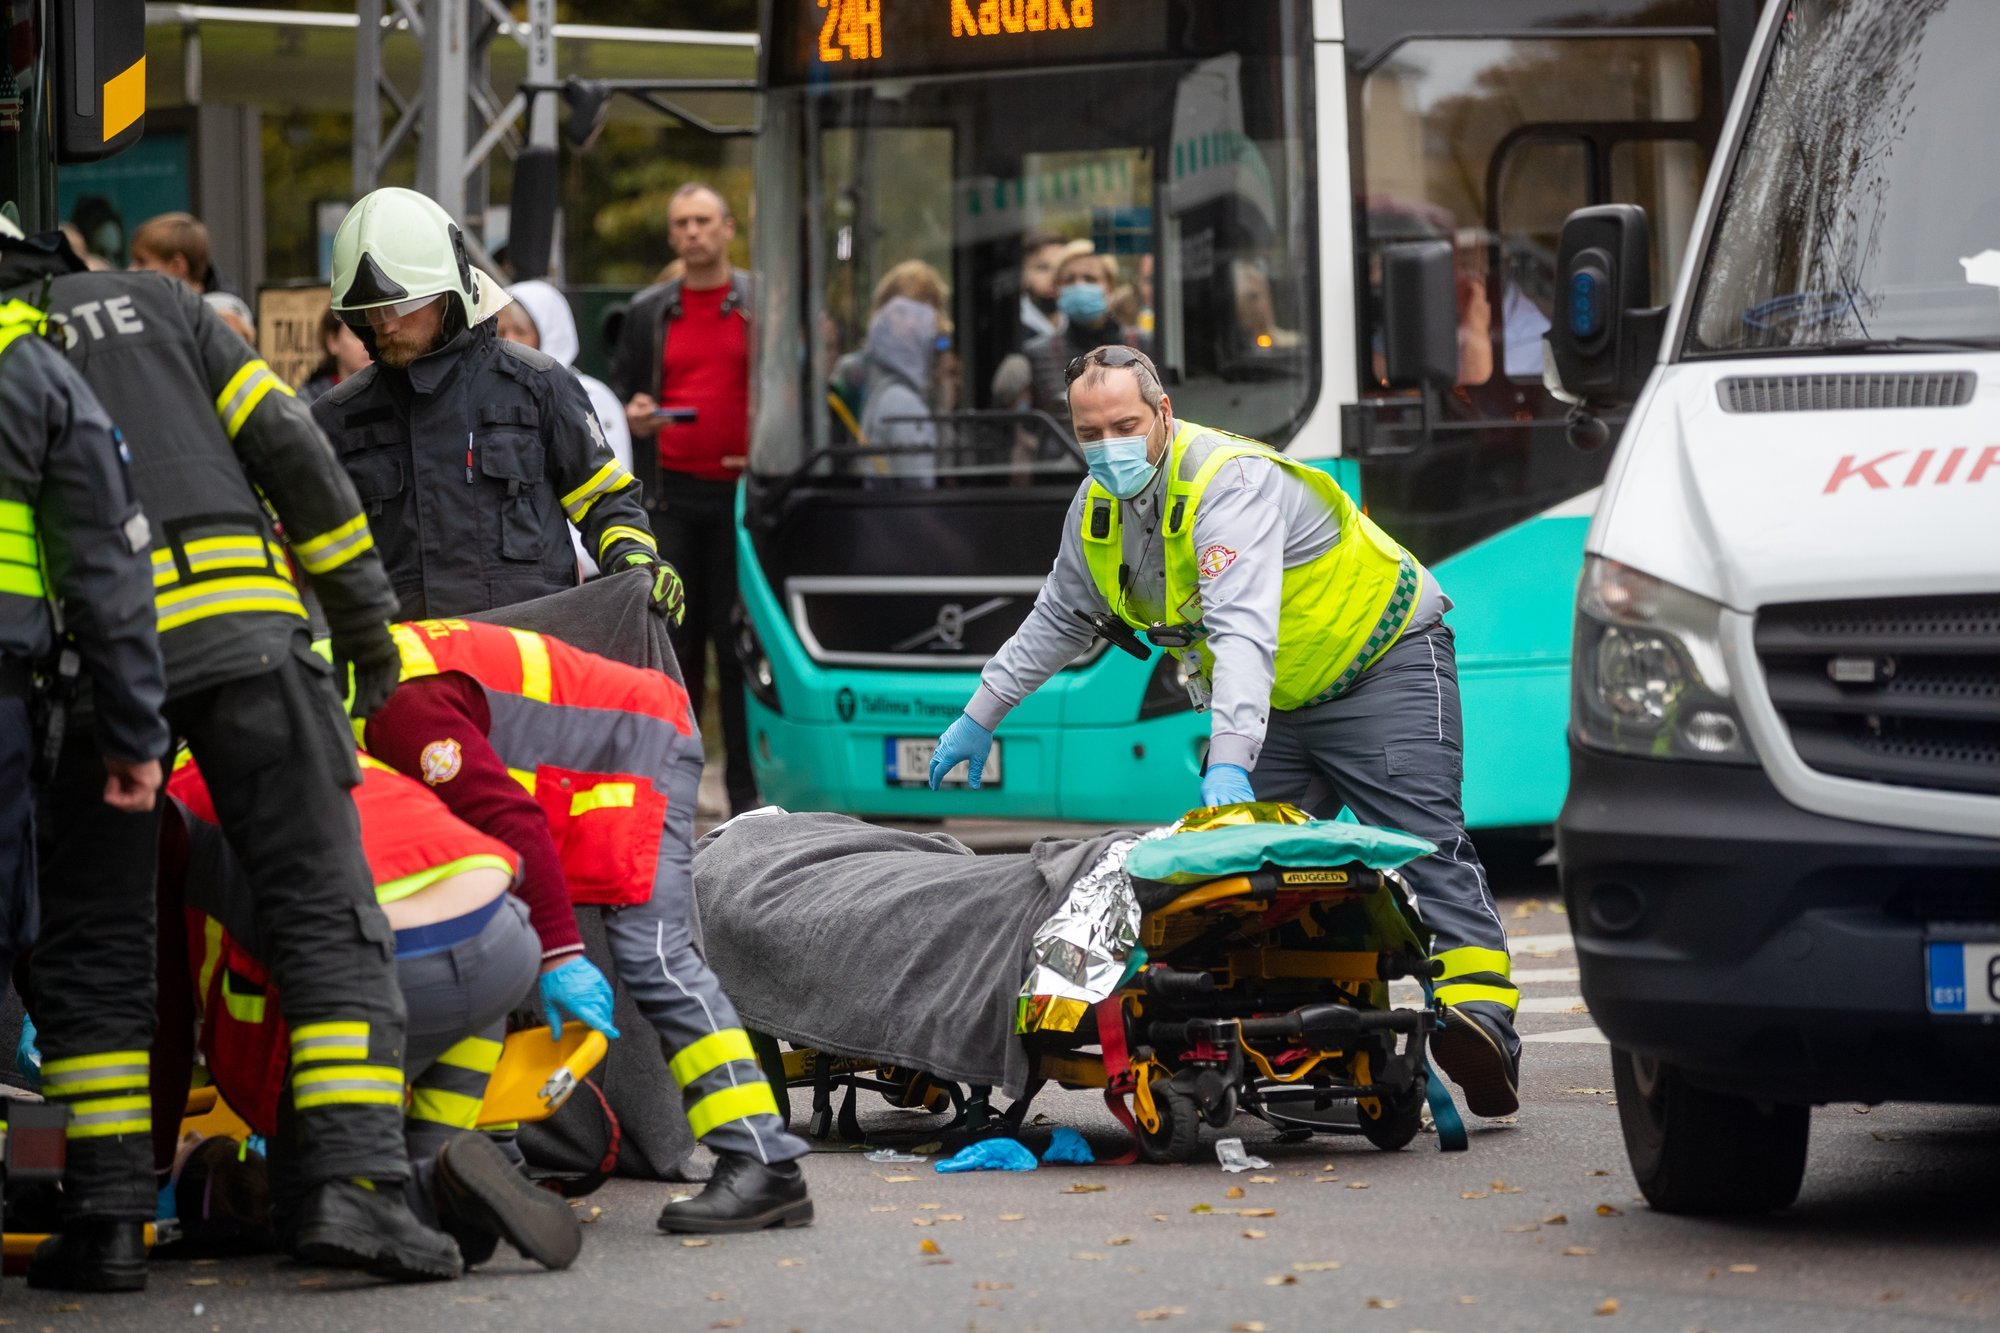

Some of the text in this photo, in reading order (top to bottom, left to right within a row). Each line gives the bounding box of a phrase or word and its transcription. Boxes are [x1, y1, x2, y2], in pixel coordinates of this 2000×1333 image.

[818, 0, 882, 62] 24H
[1292, 873, 1339, 882] RUGGED
[1935, 987, 1963, 1003] EST
